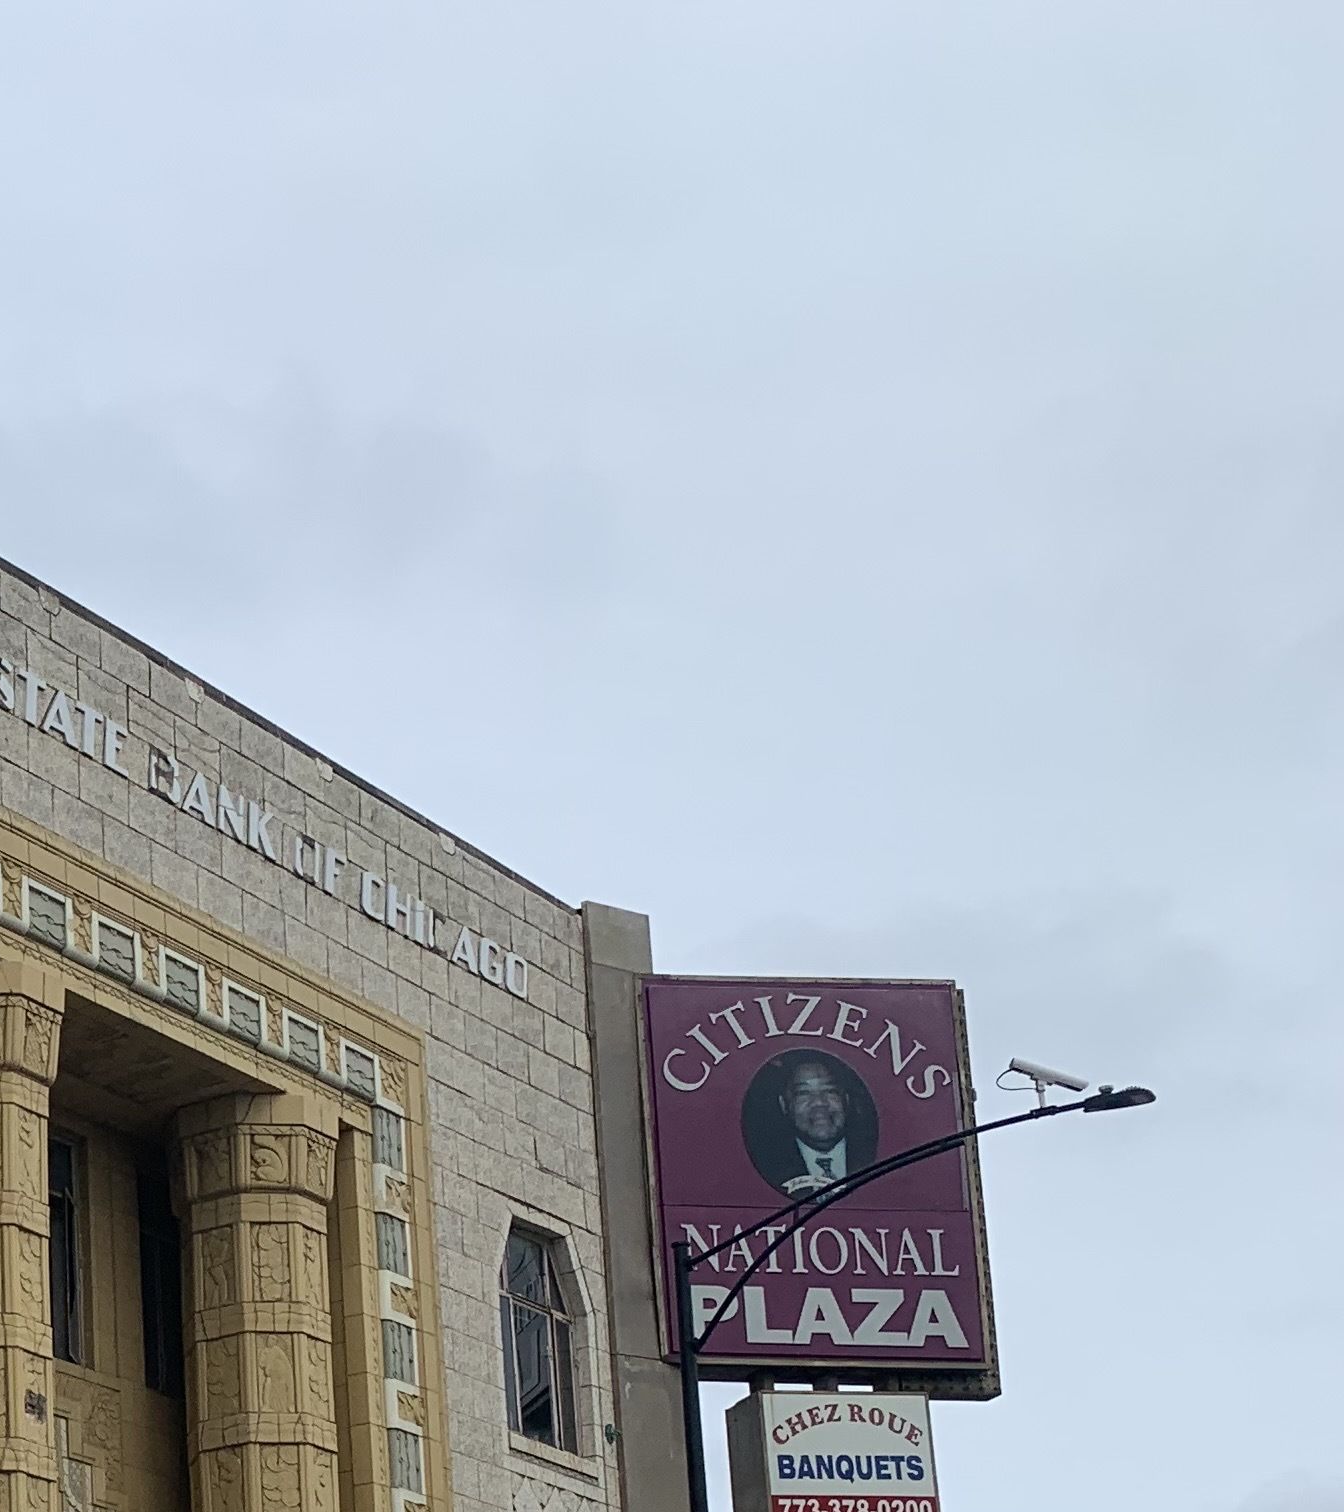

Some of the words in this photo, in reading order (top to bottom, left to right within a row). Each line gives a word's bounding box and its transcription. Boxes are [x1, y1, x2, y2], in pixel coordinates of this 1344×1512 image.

[148, 743, 279, 863] BANK
[293, 832, 347, 896] OF
[662, 993, 953, 1101] CITIZENS
[680, 1223, 960, 1277] NATIONAL
[690, 1285, 970, 1349] PLAZA
[772, 1403, 842, 1445] CHEZ
[847, 1403, 923, 1446] ROUE
[777, 1455, 924, 1484] BANQUETS
